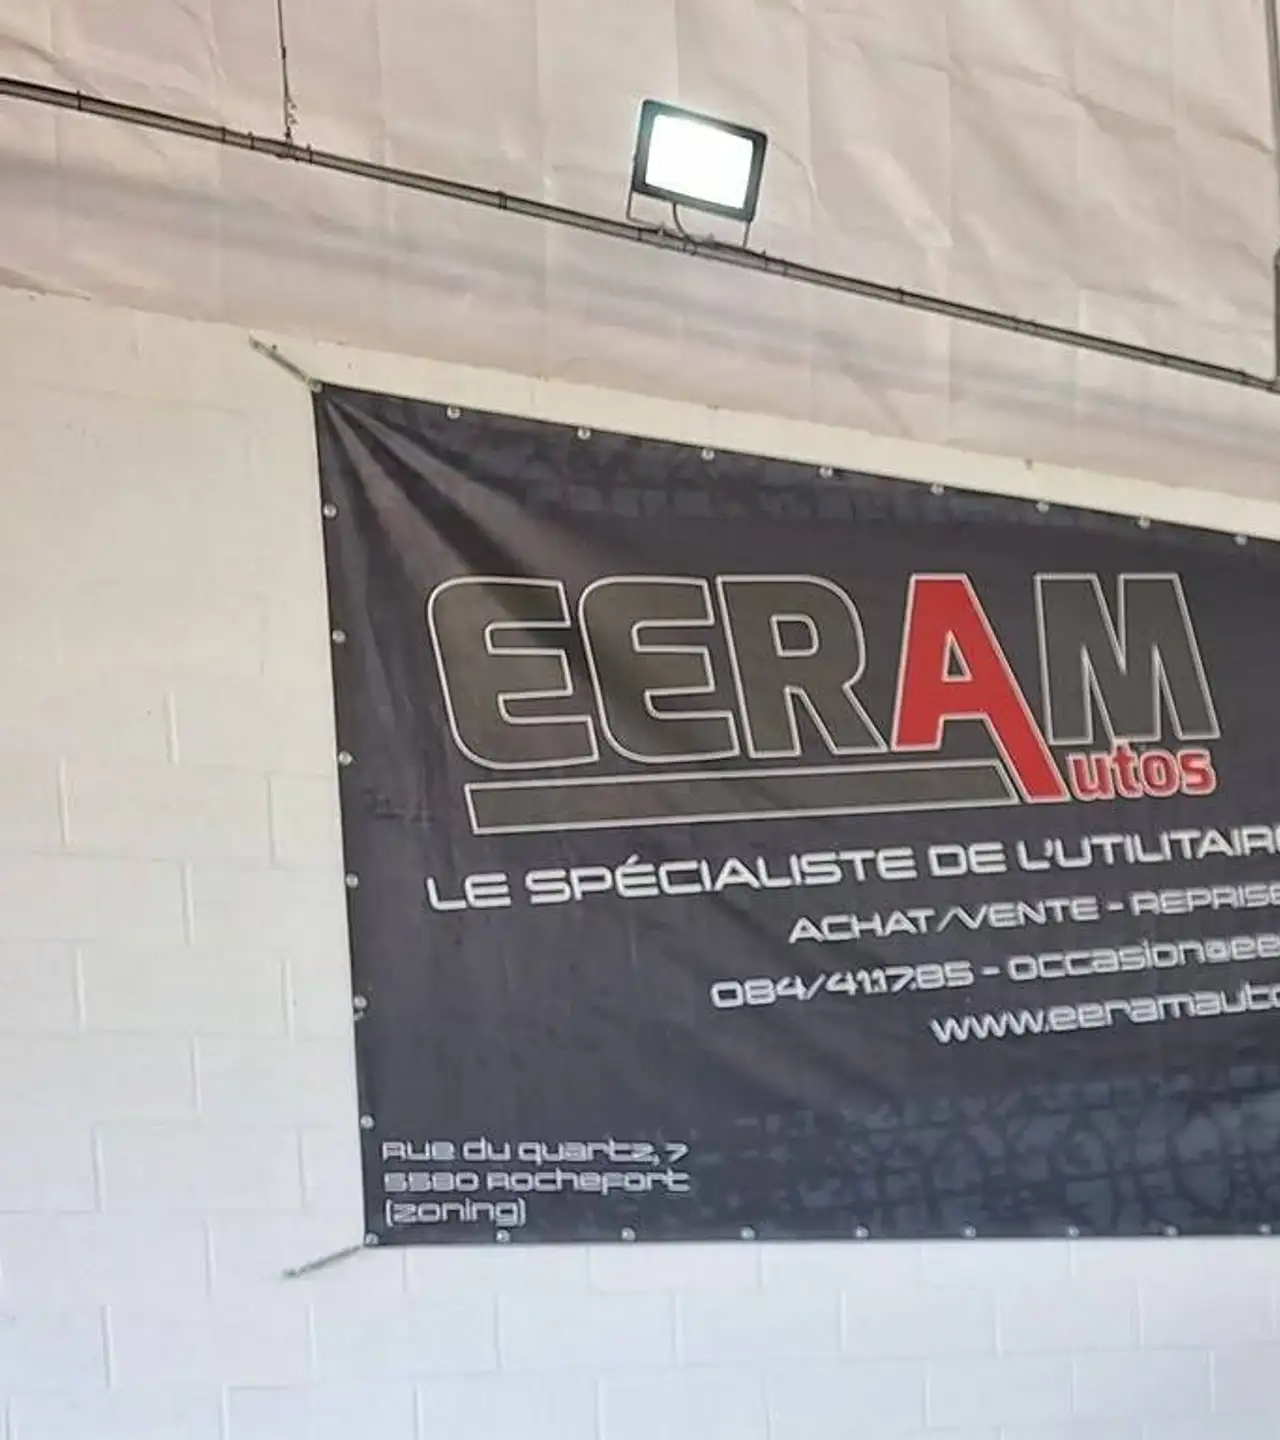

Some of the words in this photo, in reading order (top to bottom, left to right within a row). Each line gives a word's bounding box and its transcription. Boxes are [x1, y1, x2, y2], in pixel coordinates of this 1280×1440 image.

[427, 573, 1220, 802] EERAM
[426, 873, 512, 911] LE
[524, 846, 918, 905] SPÉCIALISTE
[927, 841, 1007, 878] DE
[788, 895, 1099, 944] ACHAT/VENTE
[462, 1137, 511, 1162] du
[665, 1141, 689, 1163] 7
[486, 1168, 691, 1196] Rochefort
